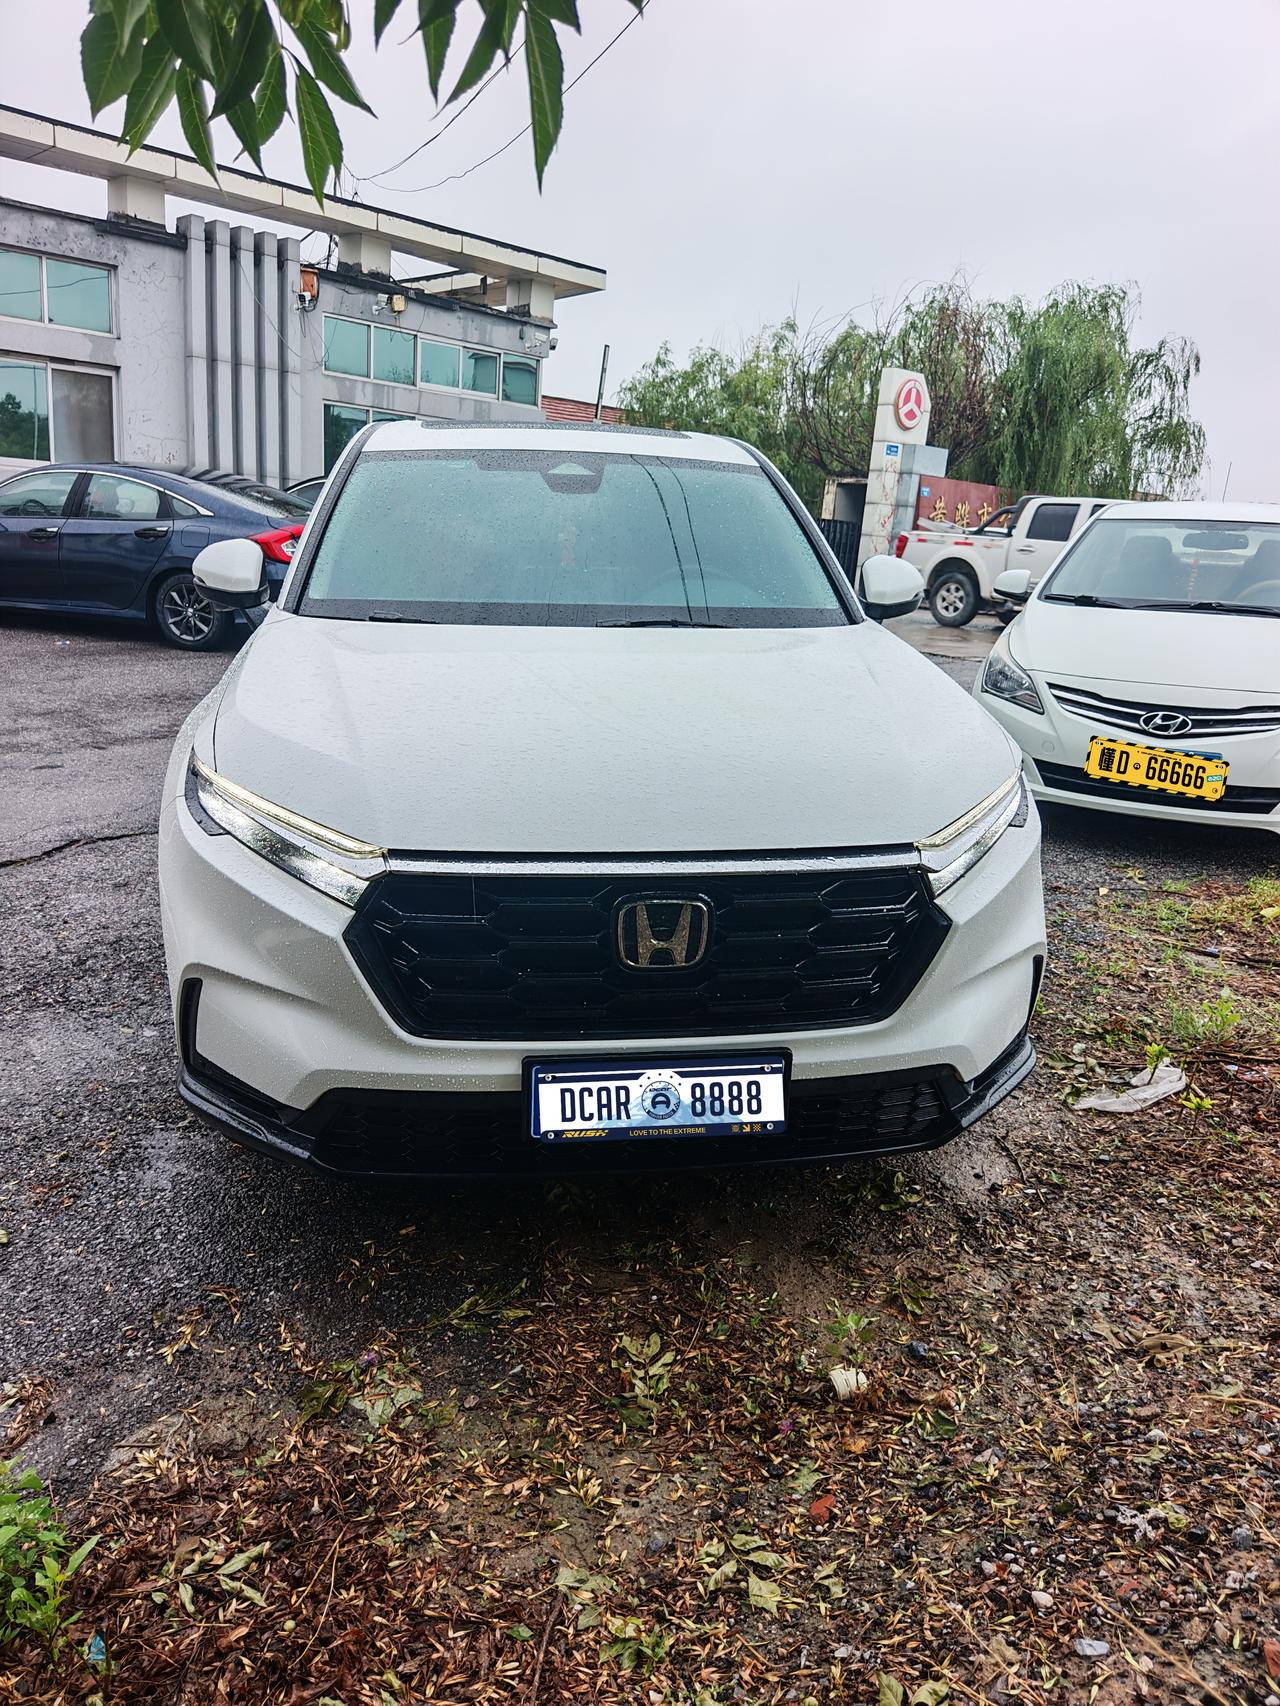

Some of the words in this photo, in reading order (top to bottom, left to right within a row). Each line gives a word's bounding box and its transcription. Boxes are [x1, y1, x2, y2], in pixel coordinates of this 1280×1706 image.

[1145, 756, 1206, 790] 66666
[560, 1085, 631, 1122] DCAR
[691, 1080, 762, 1117] 8888
[562, 1129, 609, 1138] RUSH
[629, 1129, 648, 1137] LOVE
[673, 1126, 706, 1135] EXTREME
